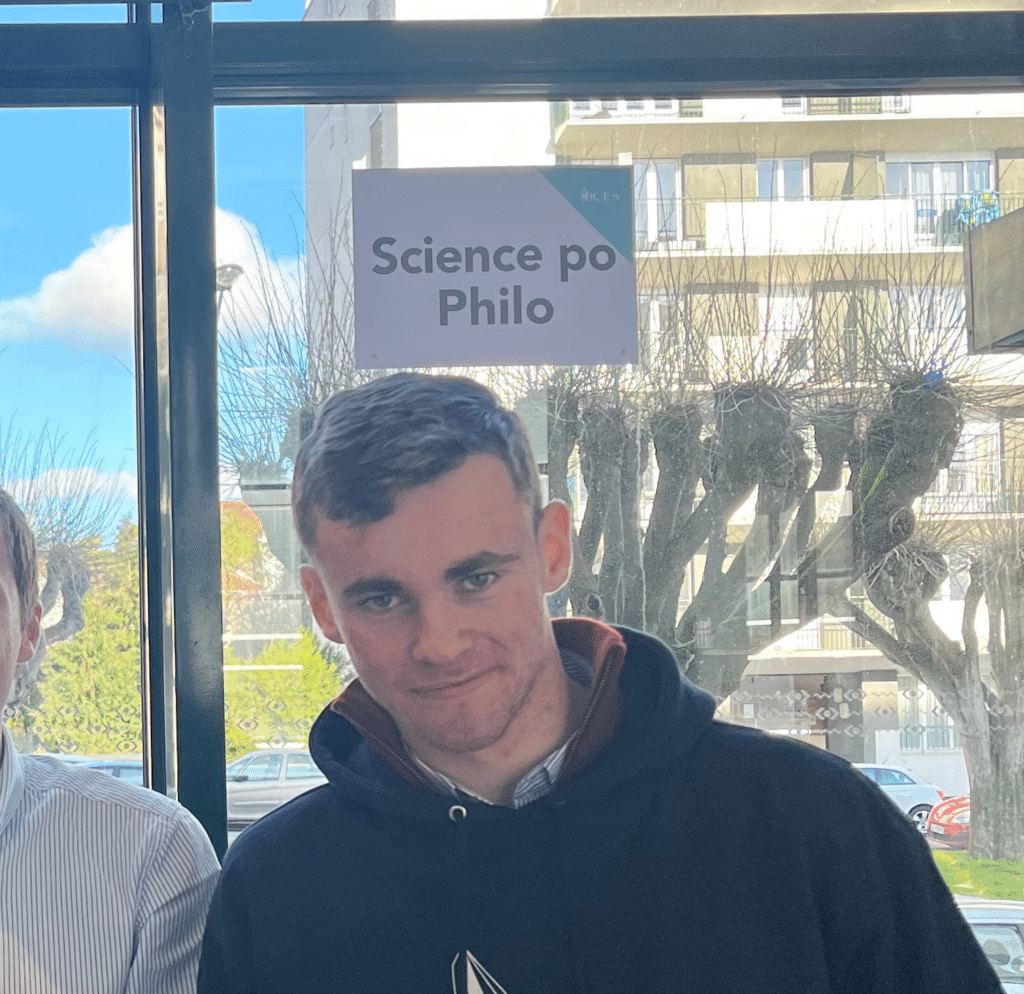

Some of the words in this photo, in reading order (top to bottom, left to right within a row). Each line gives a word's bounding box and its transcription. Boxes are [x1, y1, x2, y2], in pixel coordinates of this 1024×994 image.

[371, 235, 543, 275] Science
[559, 244, 617, 282] po
[439, 284, 554, 326] Philo
